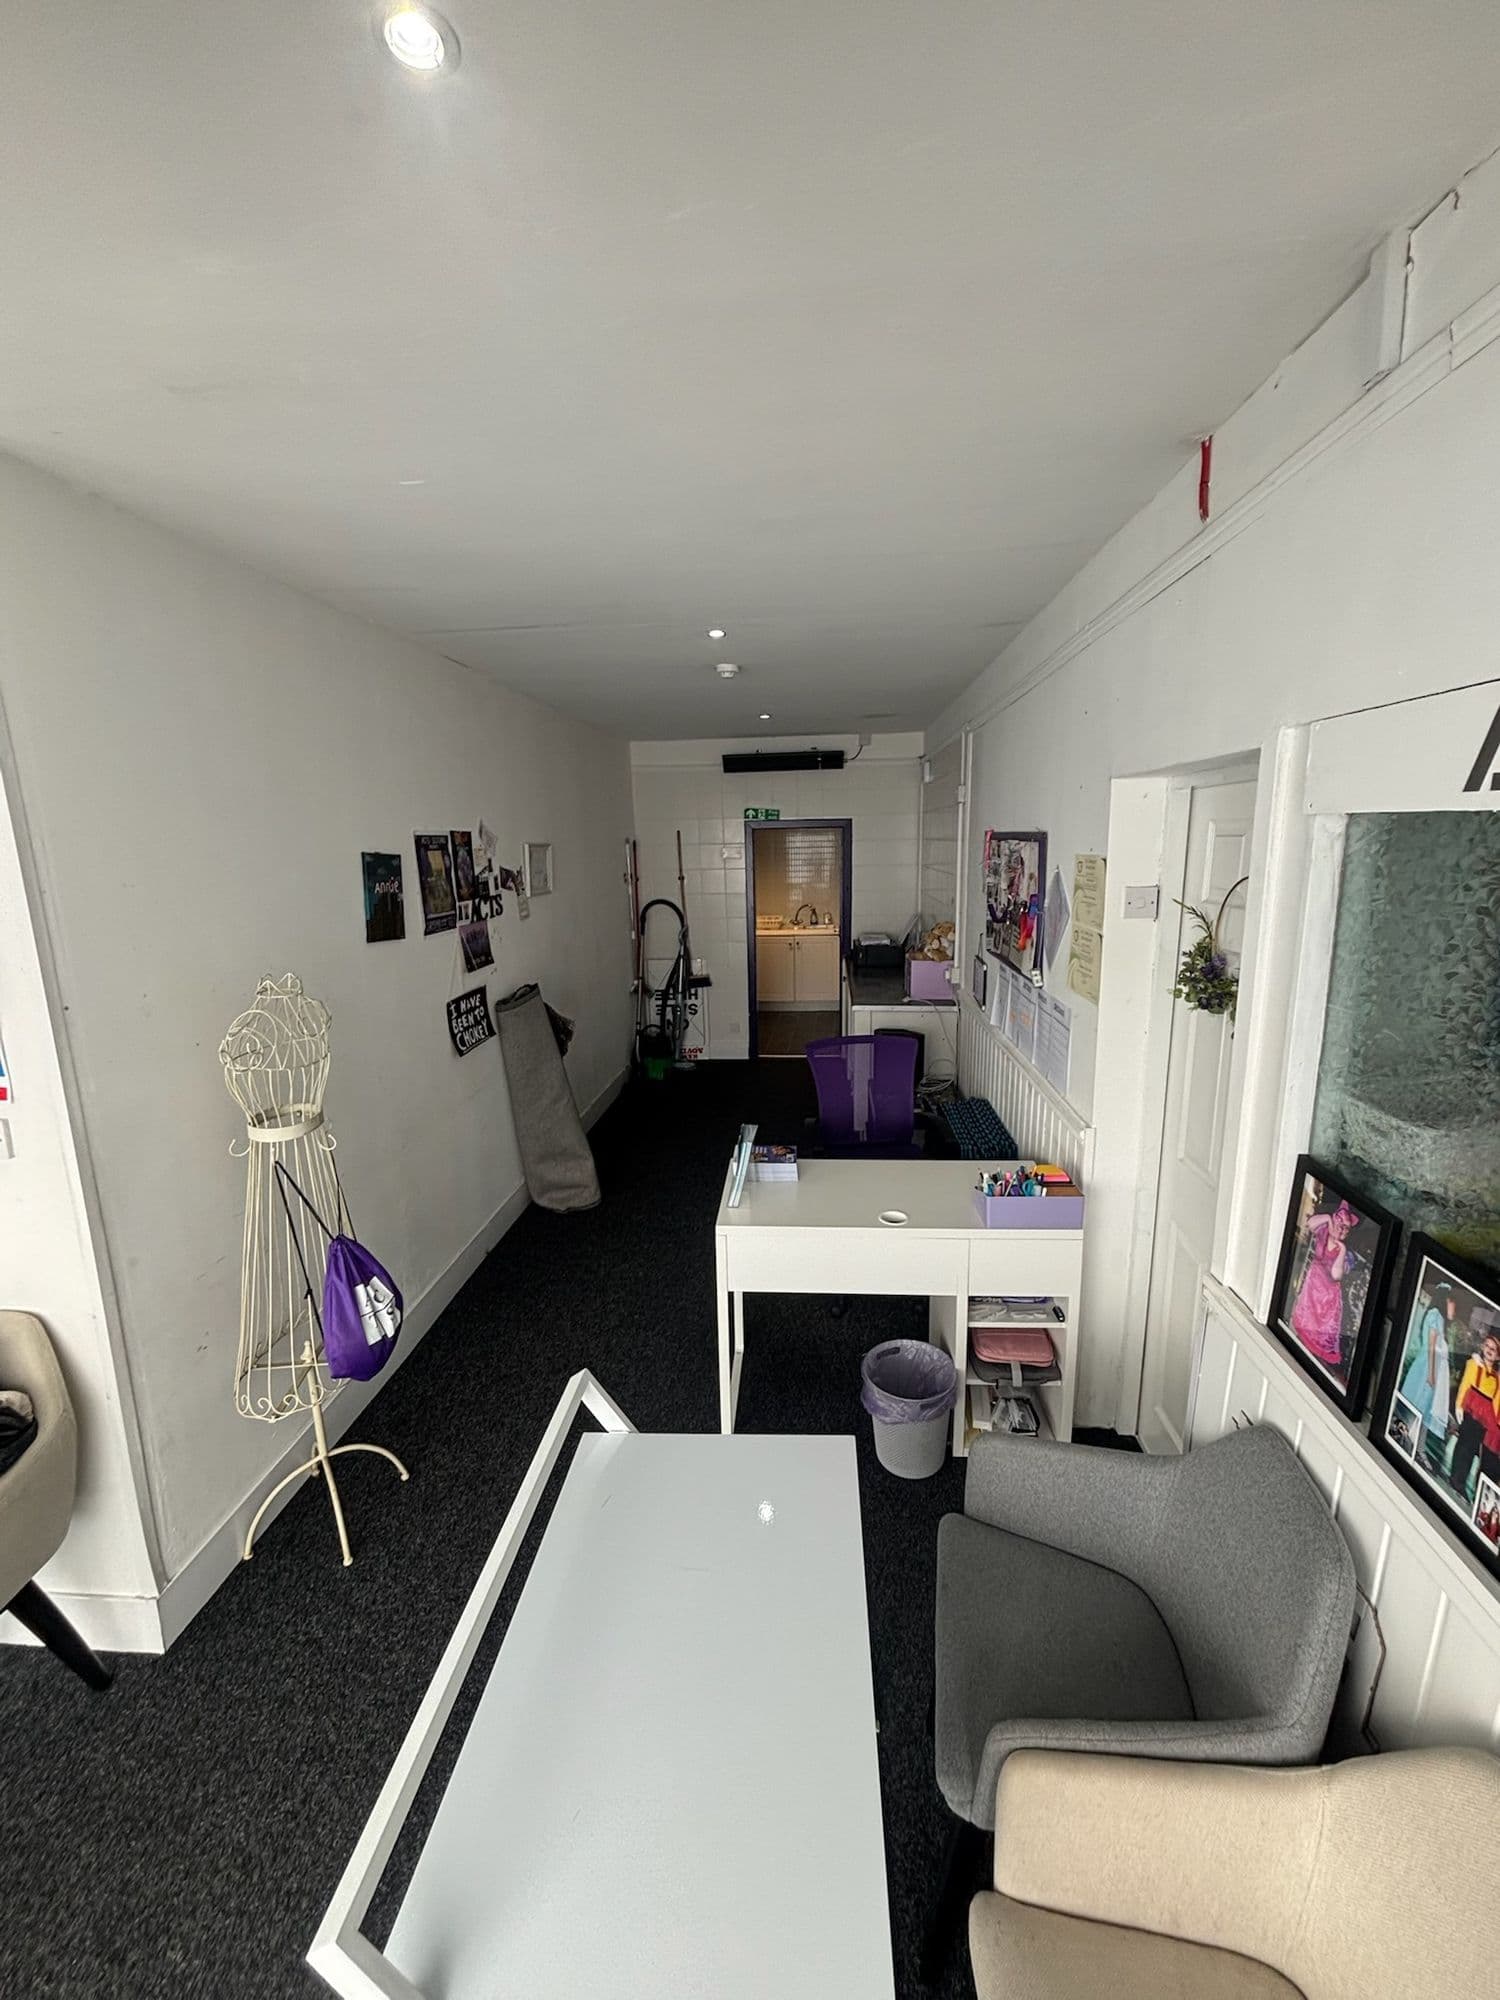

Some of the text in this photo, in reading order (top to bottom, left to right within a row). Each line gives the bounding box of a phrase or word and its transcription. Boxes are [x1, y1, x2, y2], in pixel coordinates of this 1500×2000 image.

[374, 877, 399, 894] Annie
[449, 994, 481, 1019] I HAVE
[452, 1006, 485, 1034] BEEN TO
[456, 1019, 489, 1050] CHOKEY
